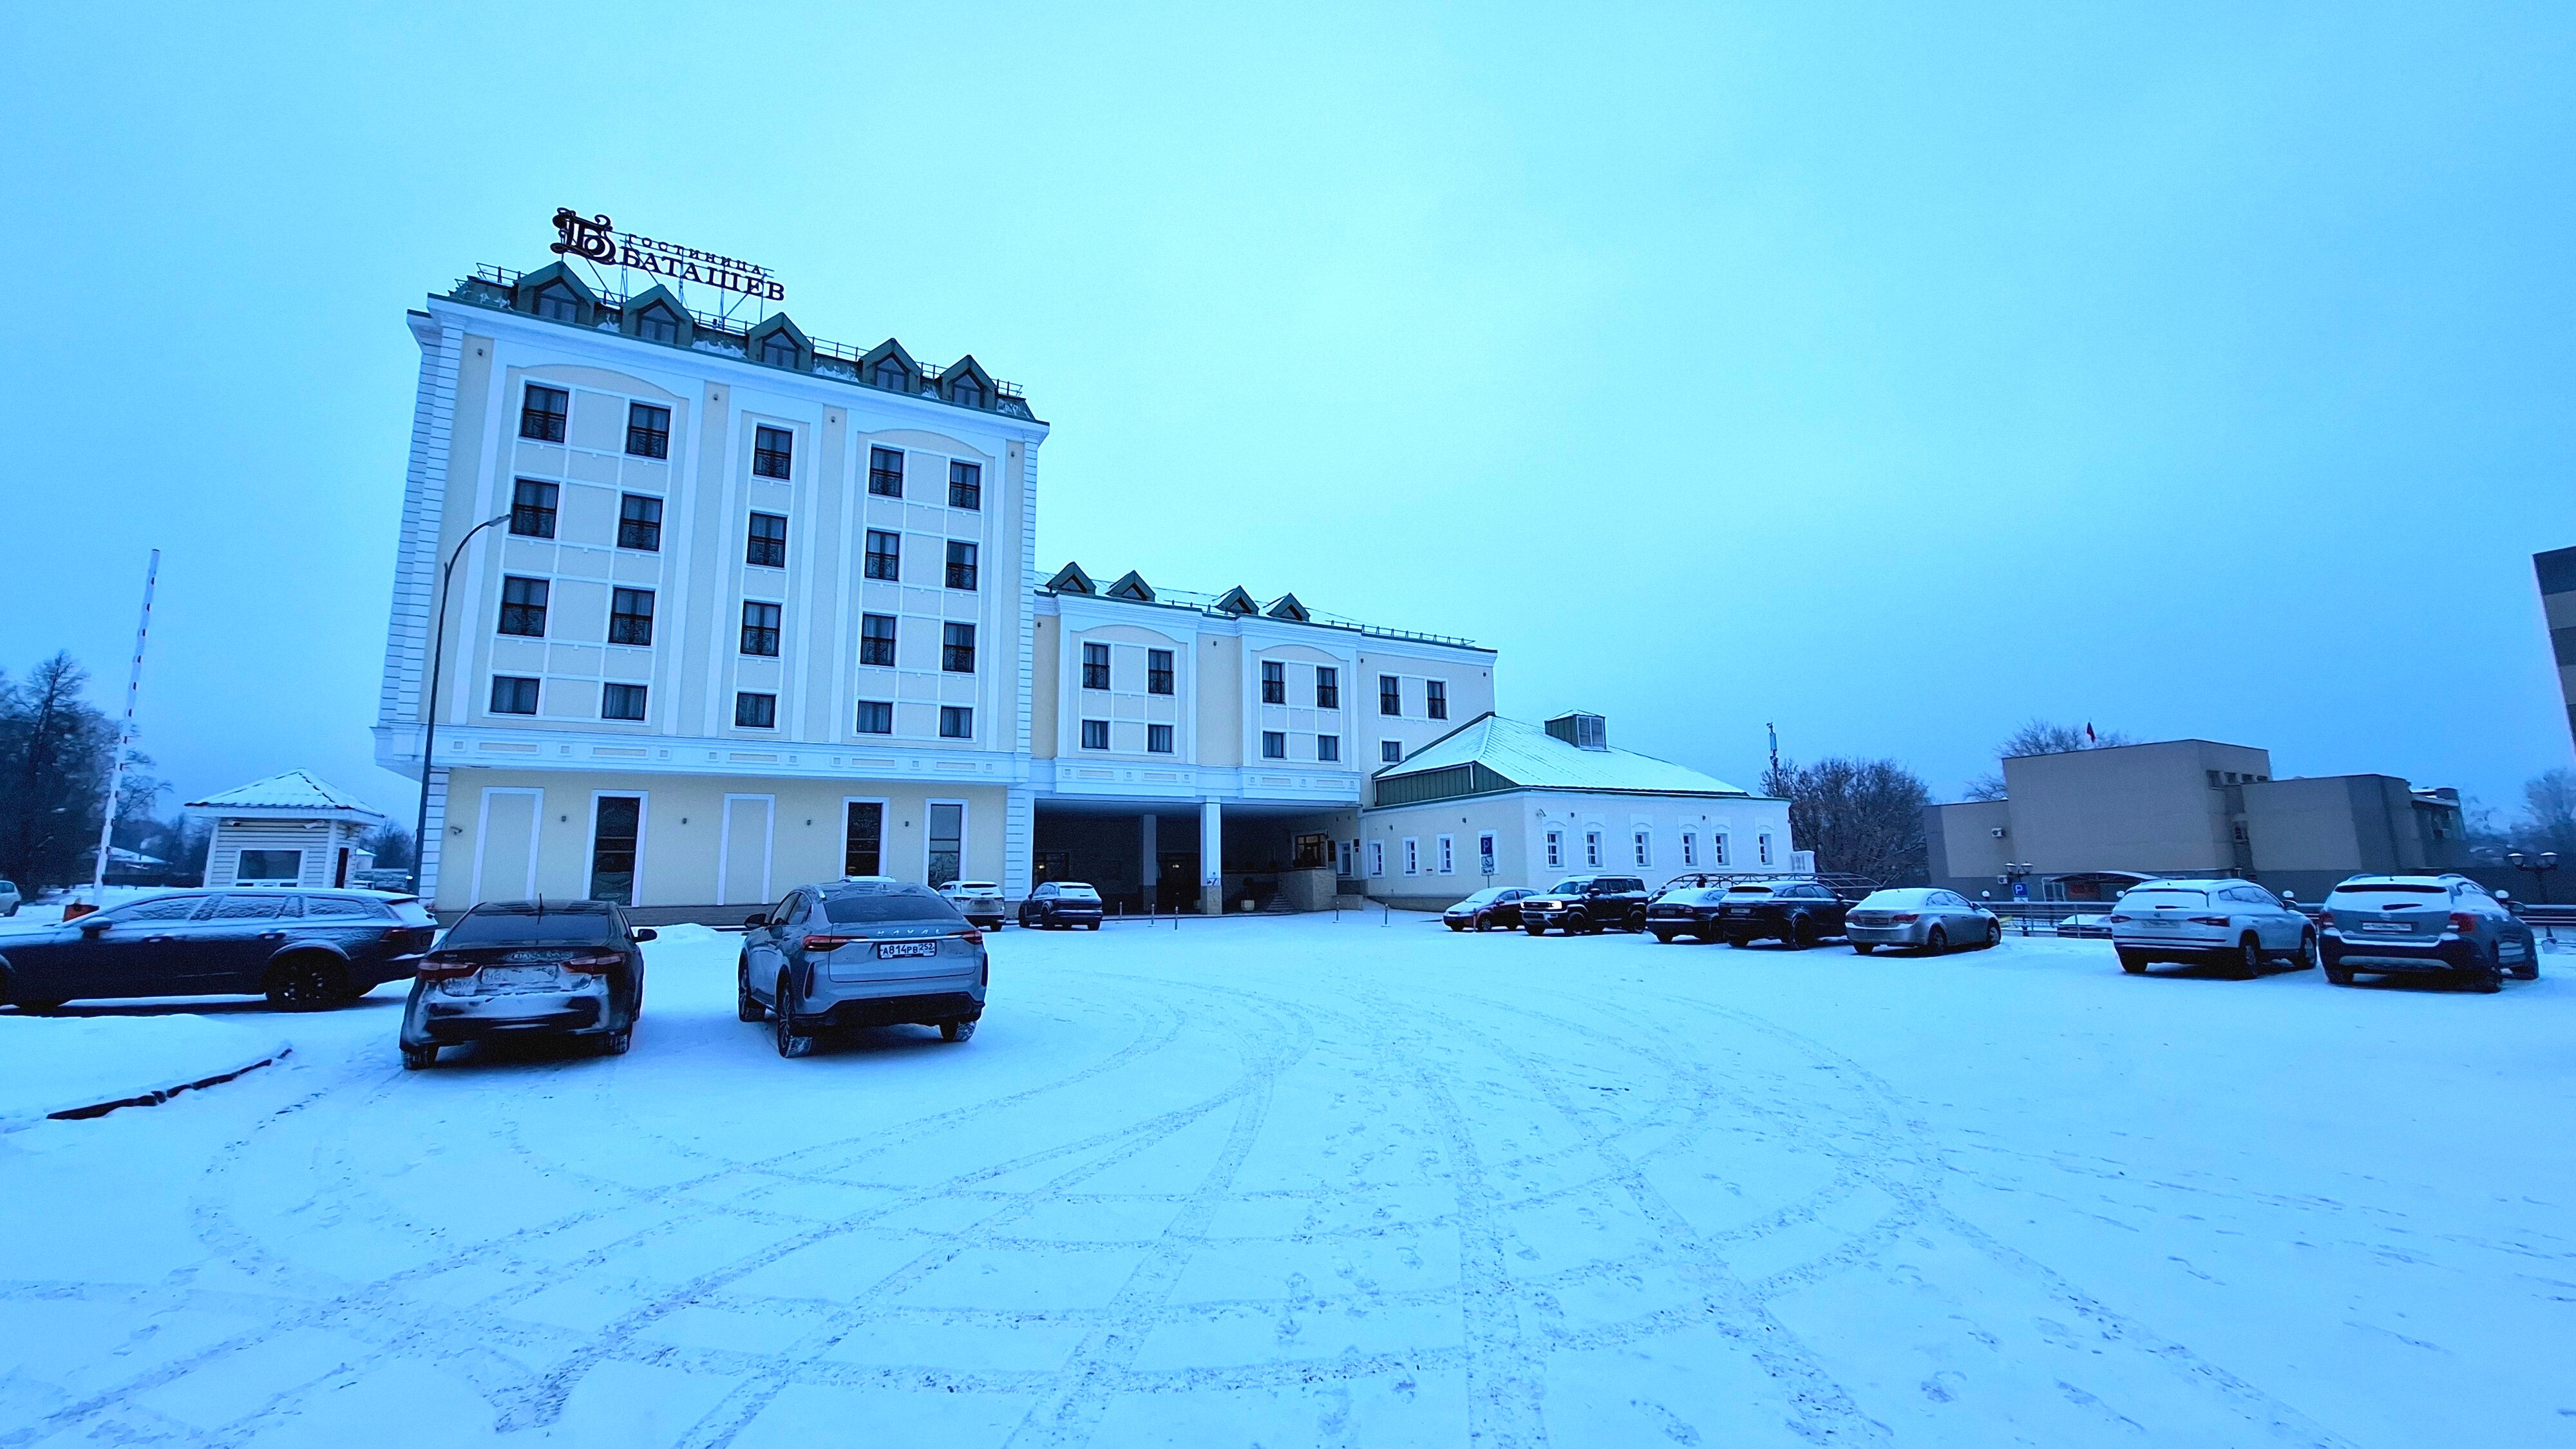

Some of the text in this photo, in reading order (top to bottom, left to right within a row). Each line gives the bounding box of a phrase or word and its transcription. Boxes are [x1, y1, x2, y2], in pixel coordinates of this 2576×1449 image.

[628, 233, 762, 276] ГОСТИНИЦА
[620, 246, 784, 301] БАТАШЕВ
[1483, 840, 1490, 853] P
[2015, 885, 2023, 895] P
